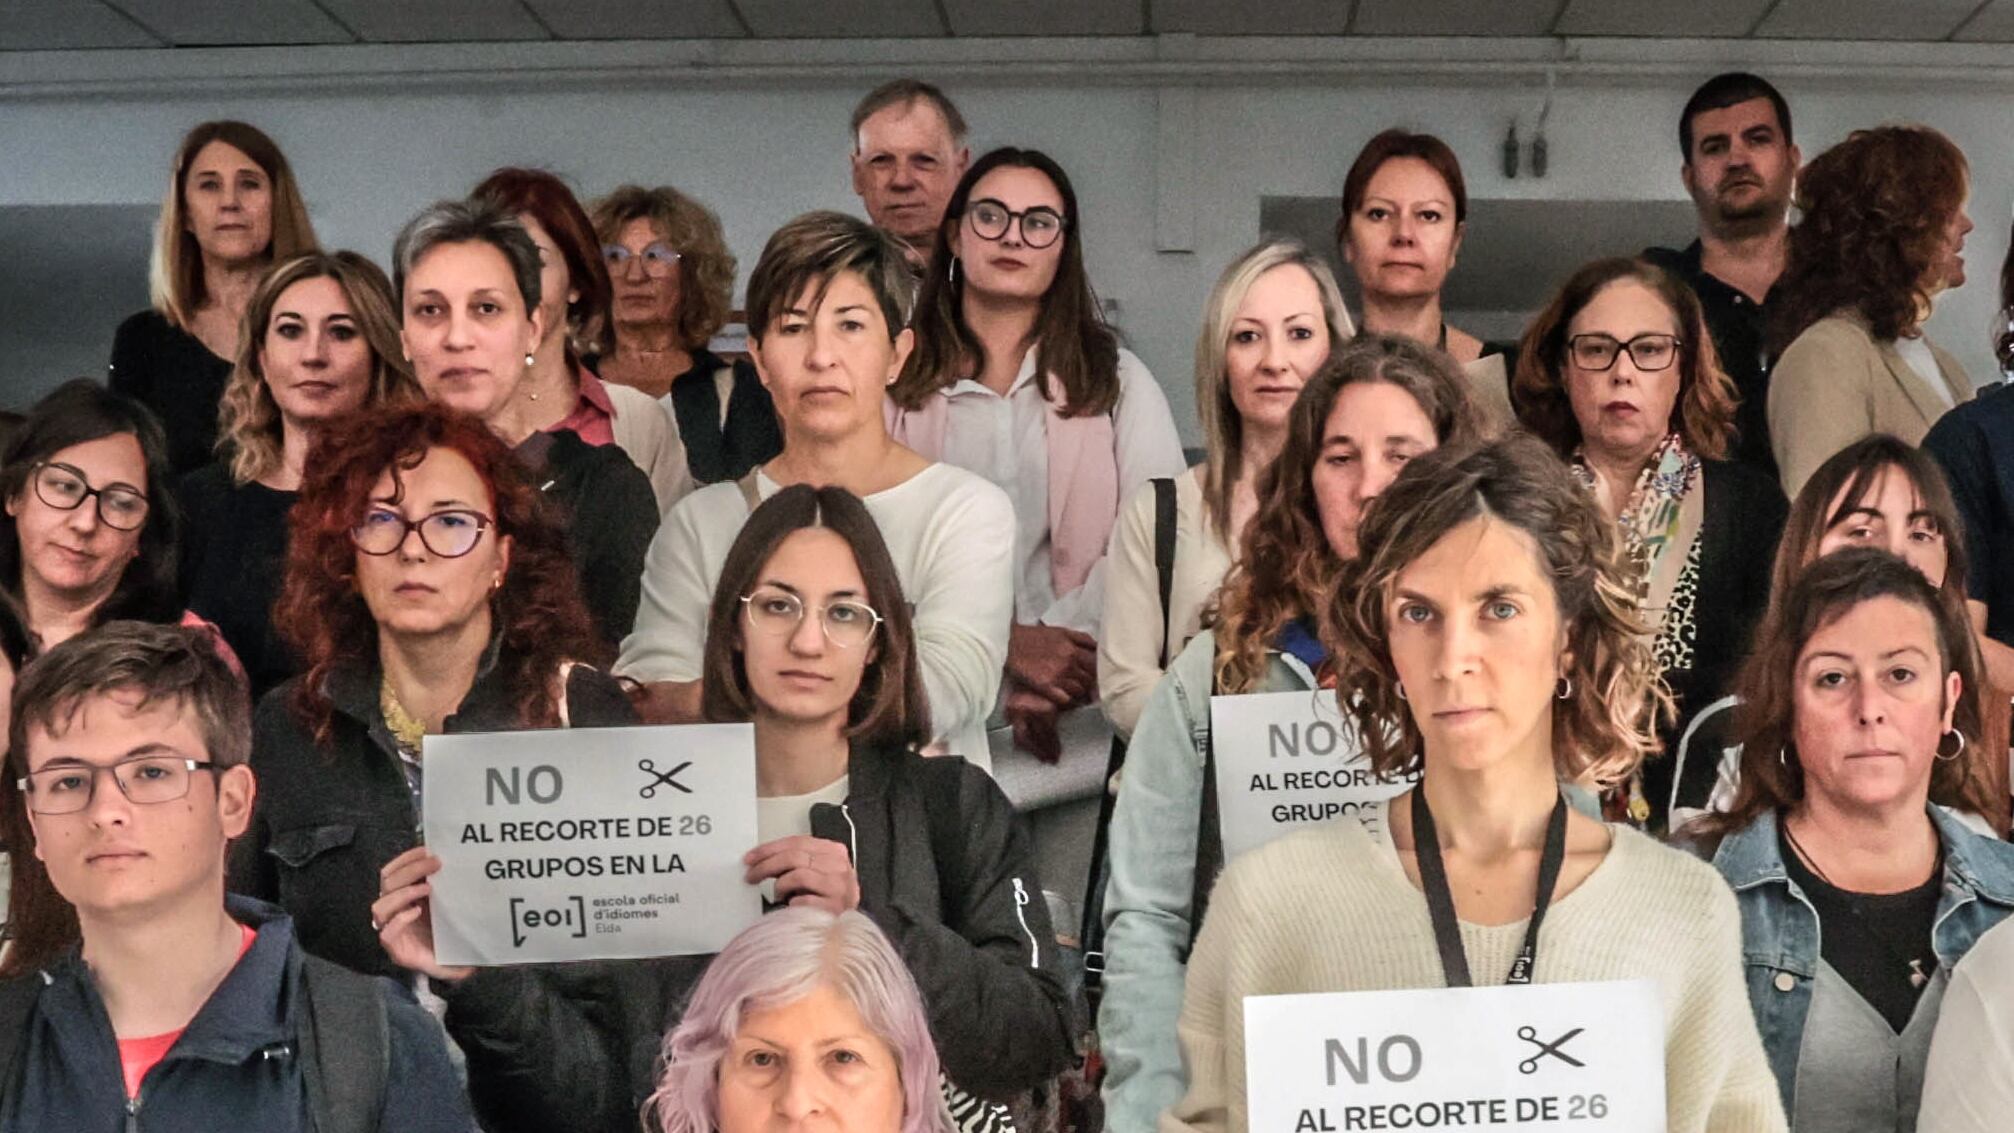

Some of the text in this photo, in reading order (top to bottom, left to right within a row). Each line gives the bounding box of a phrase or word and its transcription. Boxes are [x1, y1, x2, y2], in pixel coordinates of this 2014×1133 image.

[1268, 721, 1337, 758] NO
[485, 764, 564, 806] NO
[1250, 774, 1279, 792] AL
[460, 815, 712, 844] AL RECORTE DE 26
[485, 854, 686, 880] GRUPOS EN LA
[592, 893, 681, 907] escola oficial
[595, 923, 622, 934] Elda
[1325, 1034, 1422, 1086] NO
[1295, 1094, 1608, 1133] AL RECORTE DE 26
